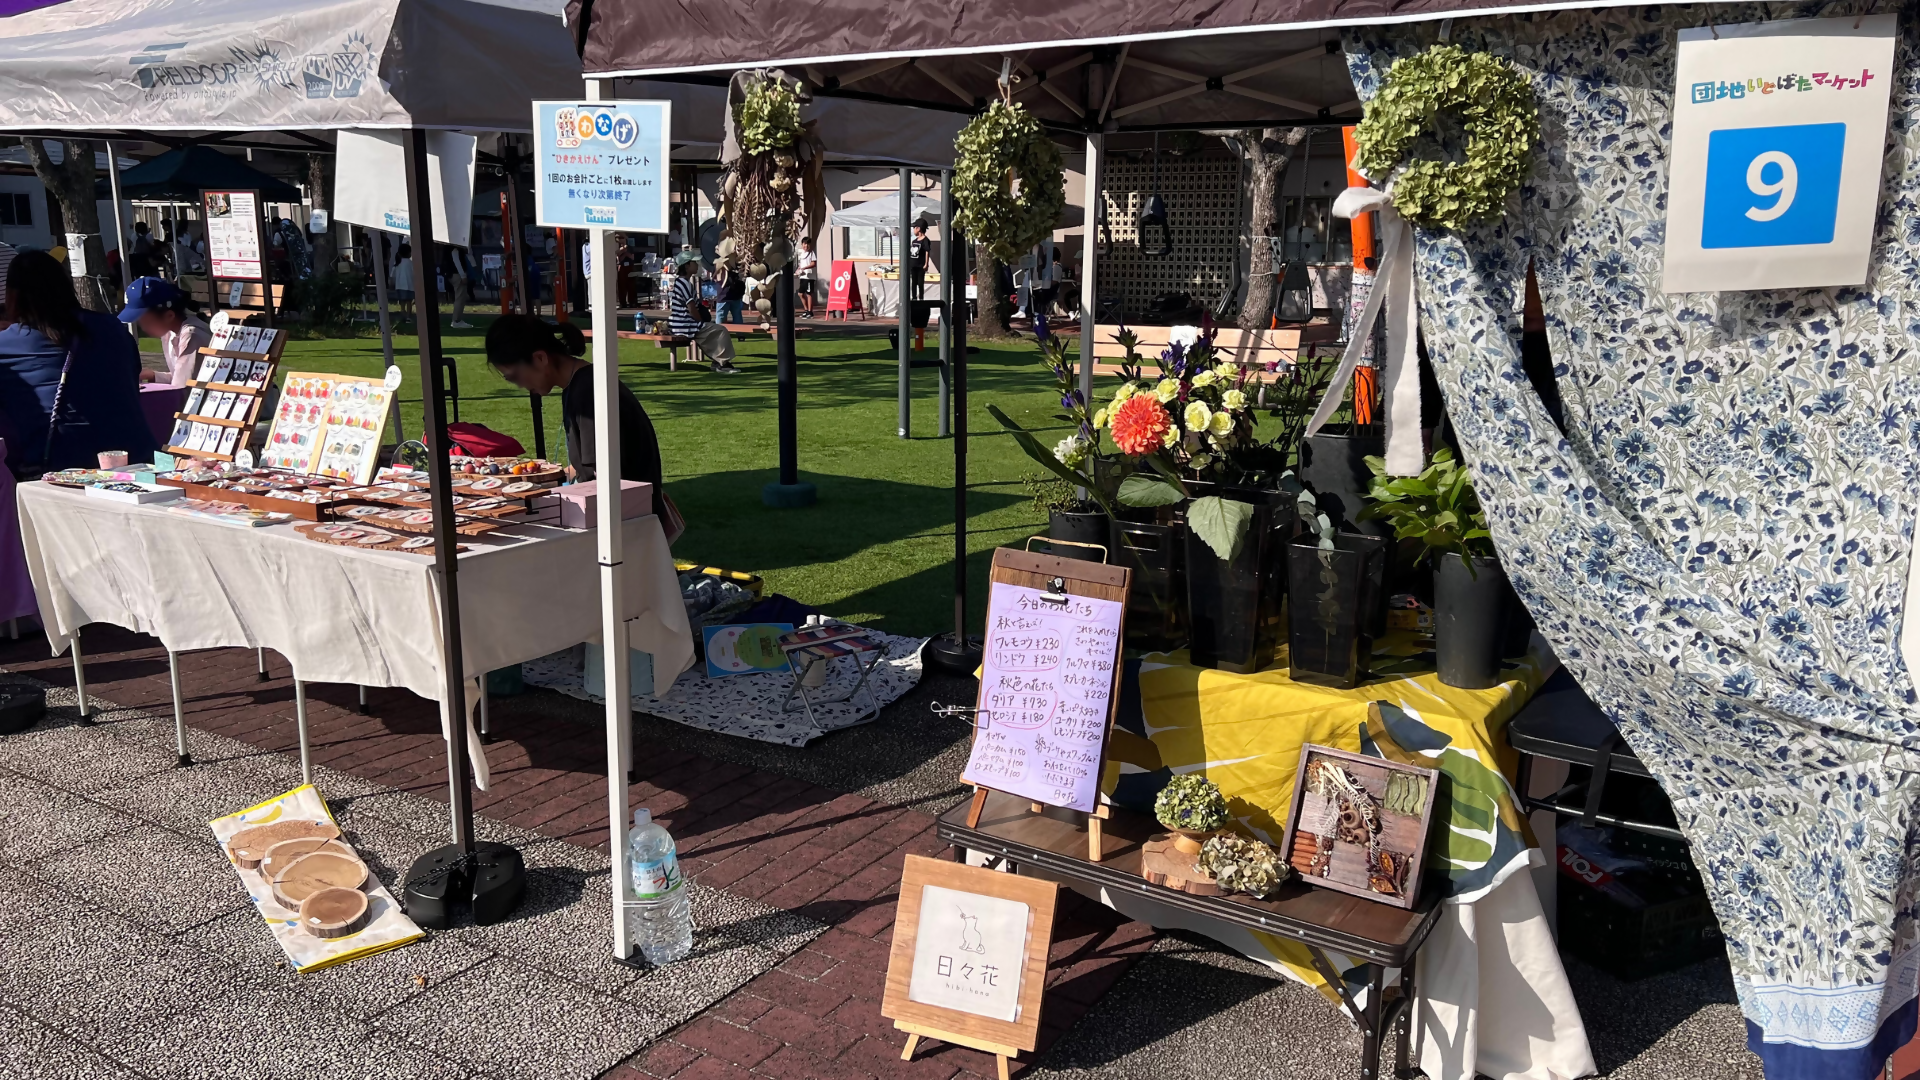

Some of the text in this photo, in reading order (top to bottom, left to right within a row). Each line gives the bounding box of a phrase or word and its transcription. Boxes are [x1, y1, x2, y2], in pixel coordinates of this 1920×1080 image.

[579, 115, 632, 142] わなげ
[608, 155, 650, 167] プレゼント
[1744, 150, 1798, 222] 9
[568, 188, 631, 202] 無くなり次第終了
[1036, 638, 1060, 650] ¥230
[995, 652, 1058, 668] リンドウ ¥240
[1084, 689, 1108, 700] ¥220
[1021, 712, 1044, 724] ¥180
[1561, 847, 1603, 883] FOIL
[937, 955, 1000, 987] 日々花
